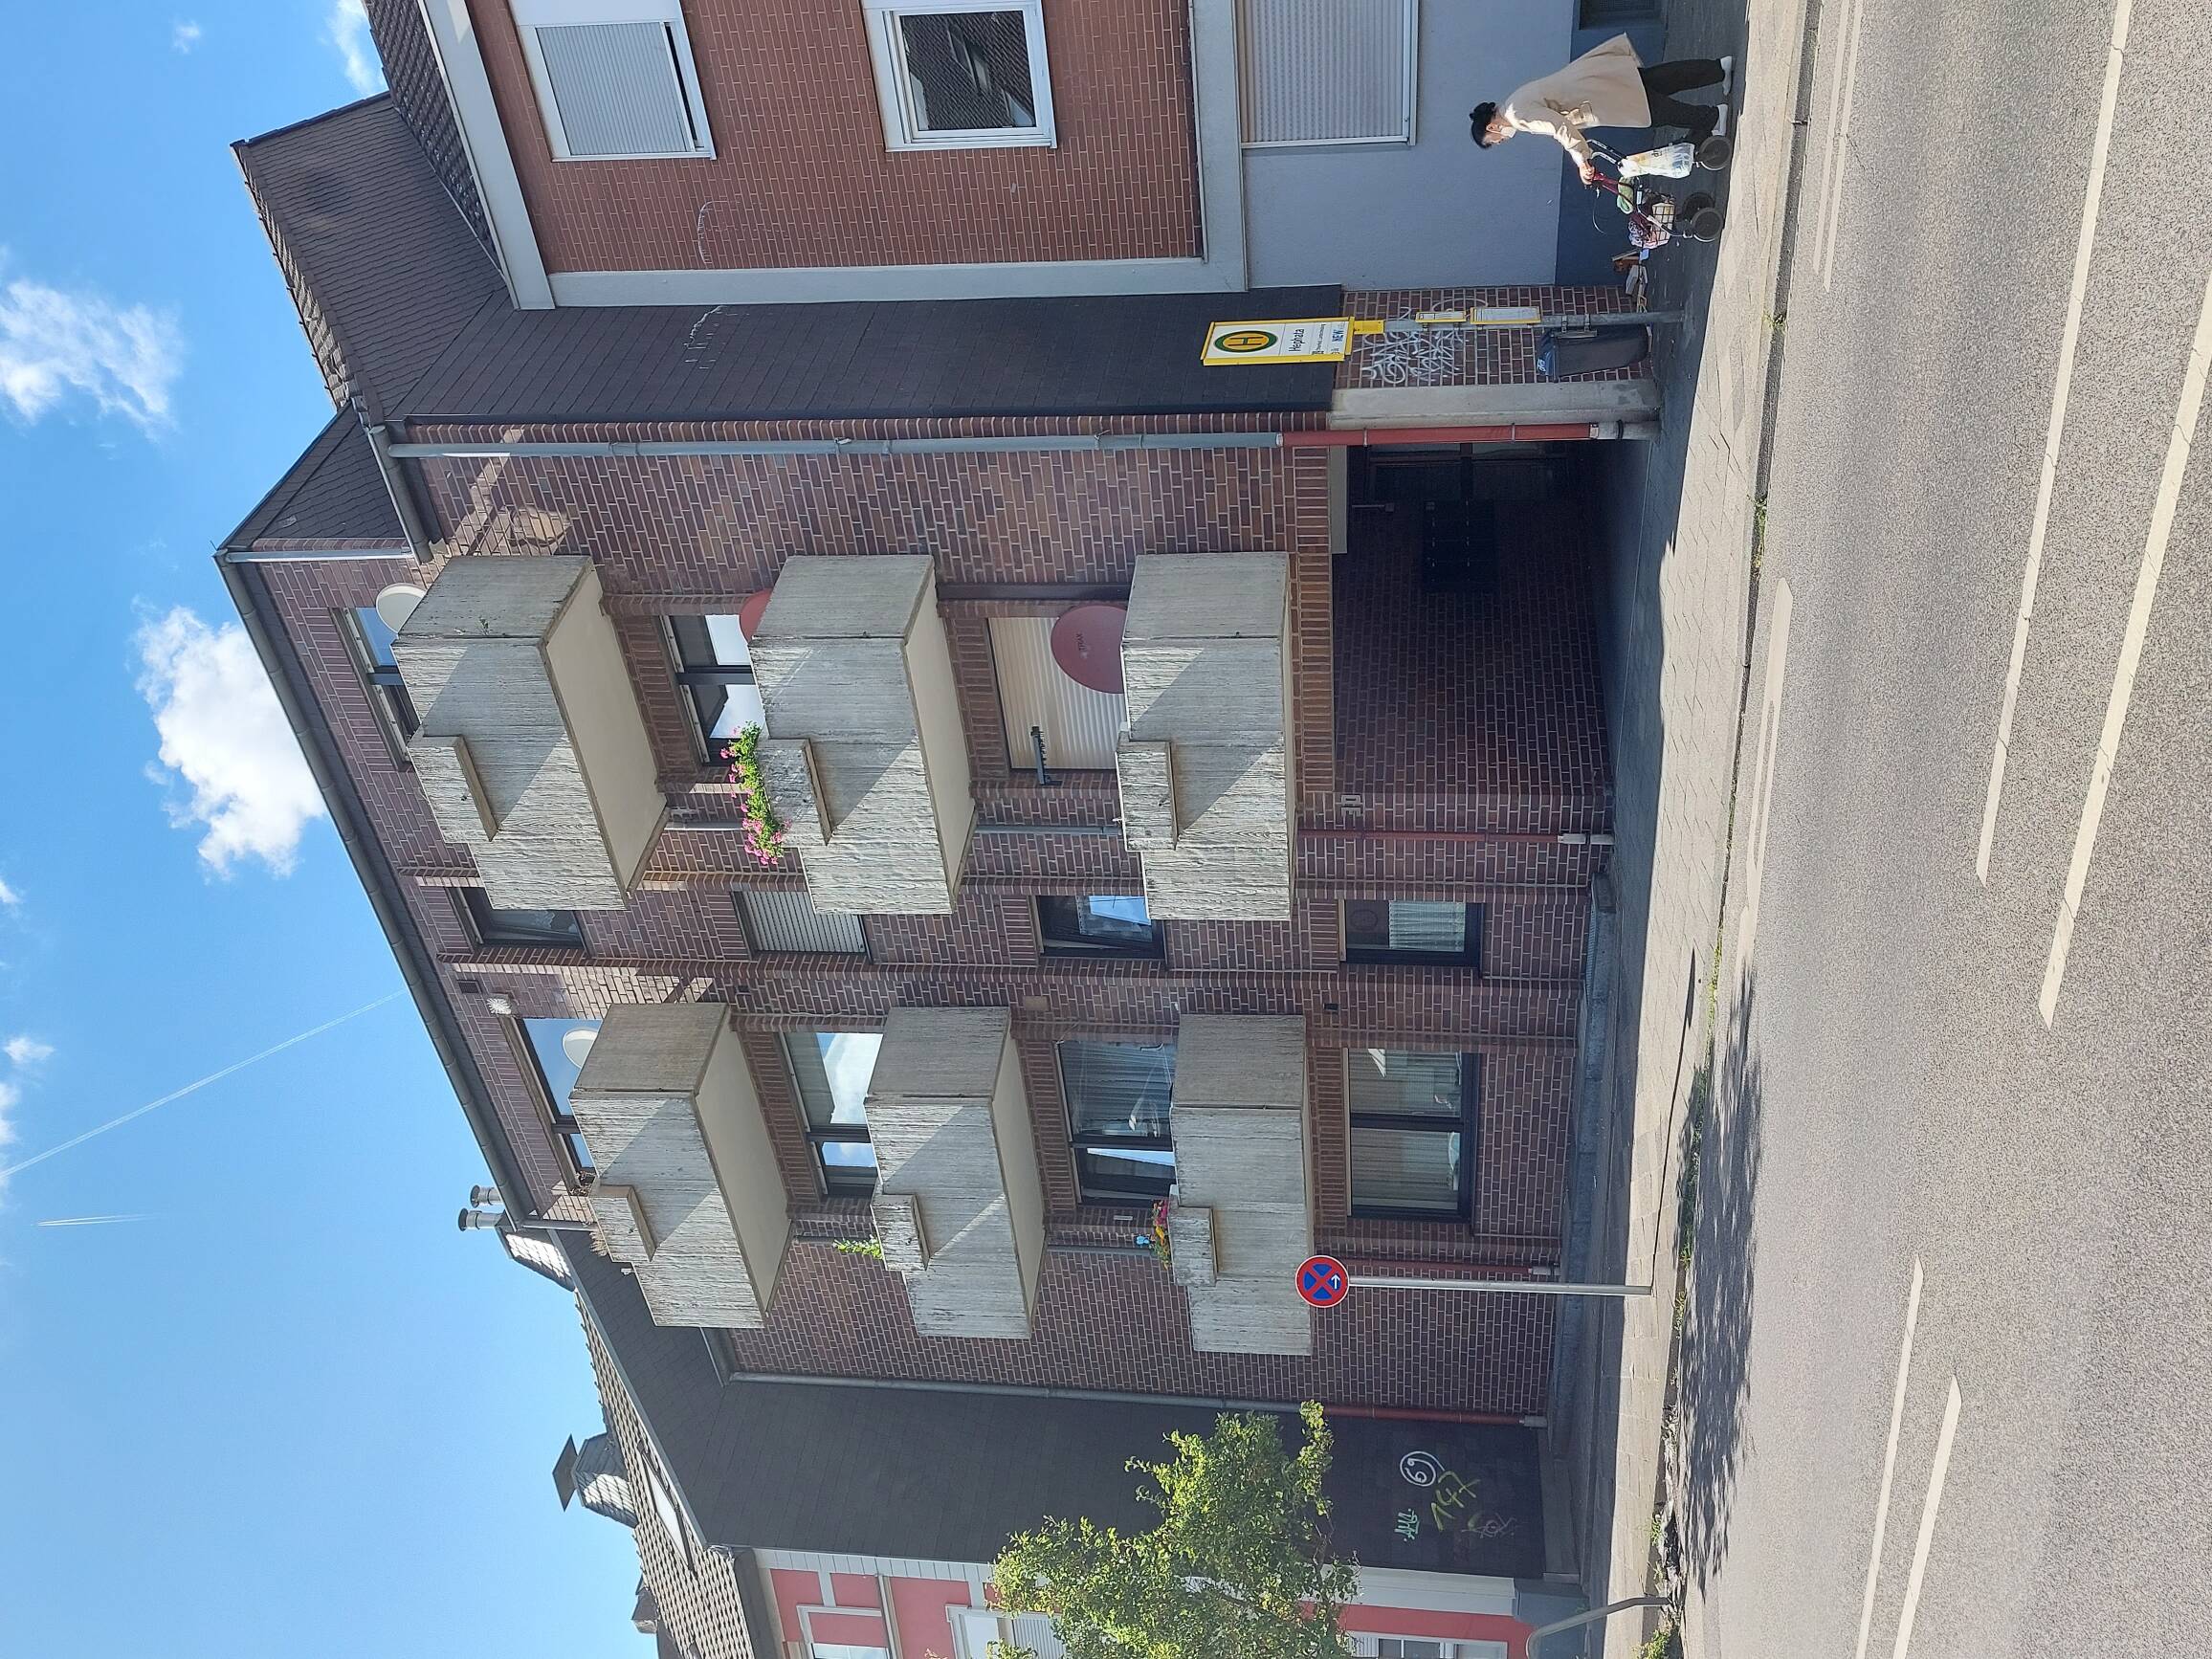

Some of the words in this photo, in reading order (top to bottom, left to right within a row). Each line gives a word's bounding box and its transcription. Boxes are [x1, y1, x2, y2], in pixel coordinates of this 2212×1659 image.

[1227, 336, 1264, 346] H
[1288, 328, 1305, 352] Hephata
[1341, 794, 1361, 817] 30
